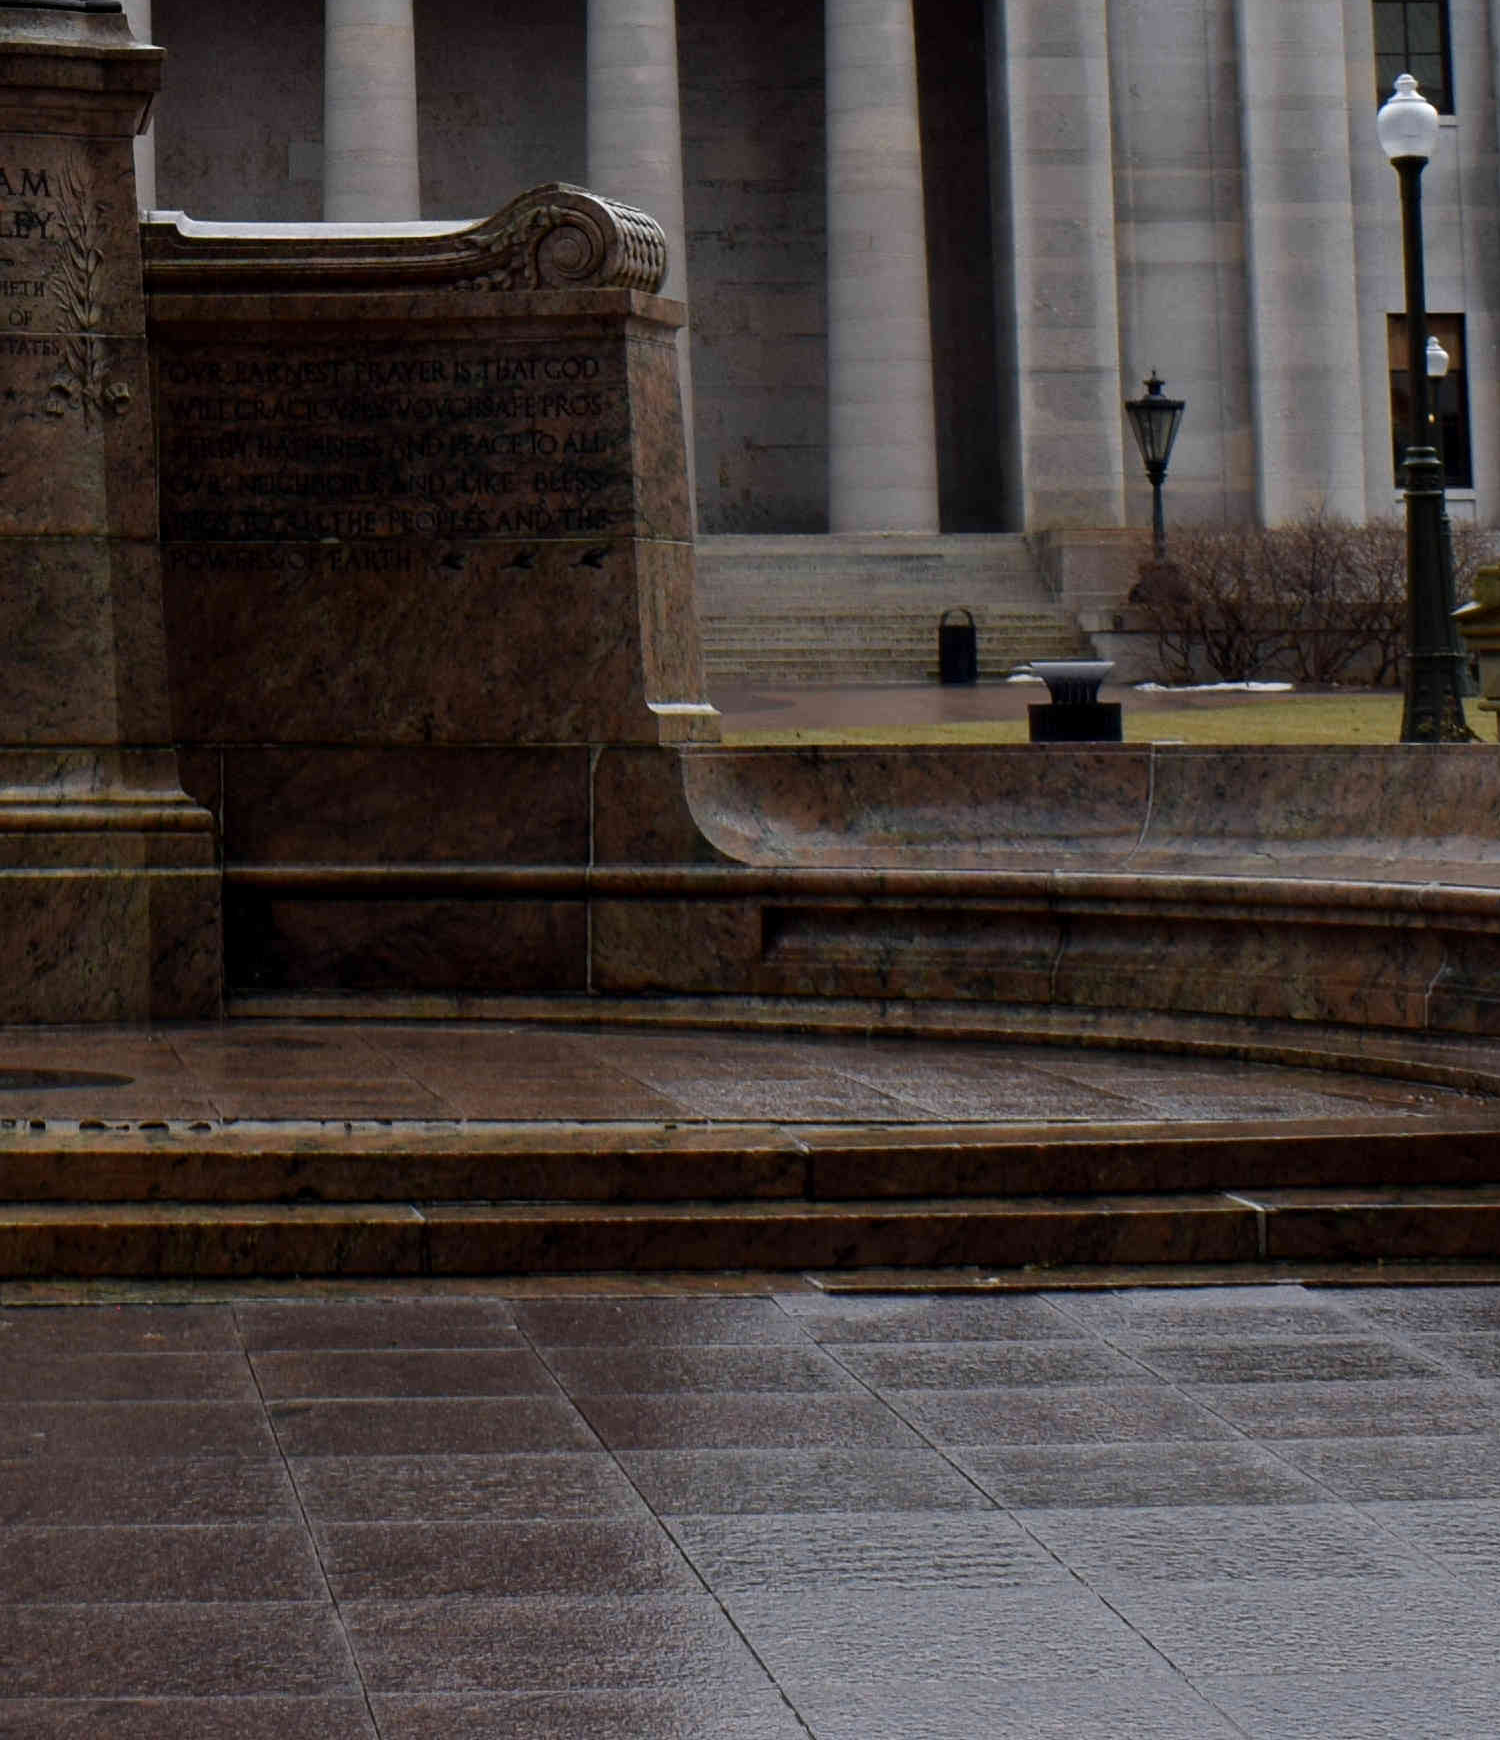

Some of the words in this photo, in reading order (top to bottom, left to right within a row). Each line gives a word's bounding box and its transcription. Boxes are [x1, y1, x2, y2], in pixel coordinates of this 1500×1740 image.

[8, 310, 32, 326] OF
[354, 360, 445, 383] PRAYER
[477, 358, 541, 381] THAT
[544, 356, 599, 379] GOD
[525, 429, 558, 455] TO
[563, 432, 608, 453] ALL
[497, 506, 553, 531] AND
